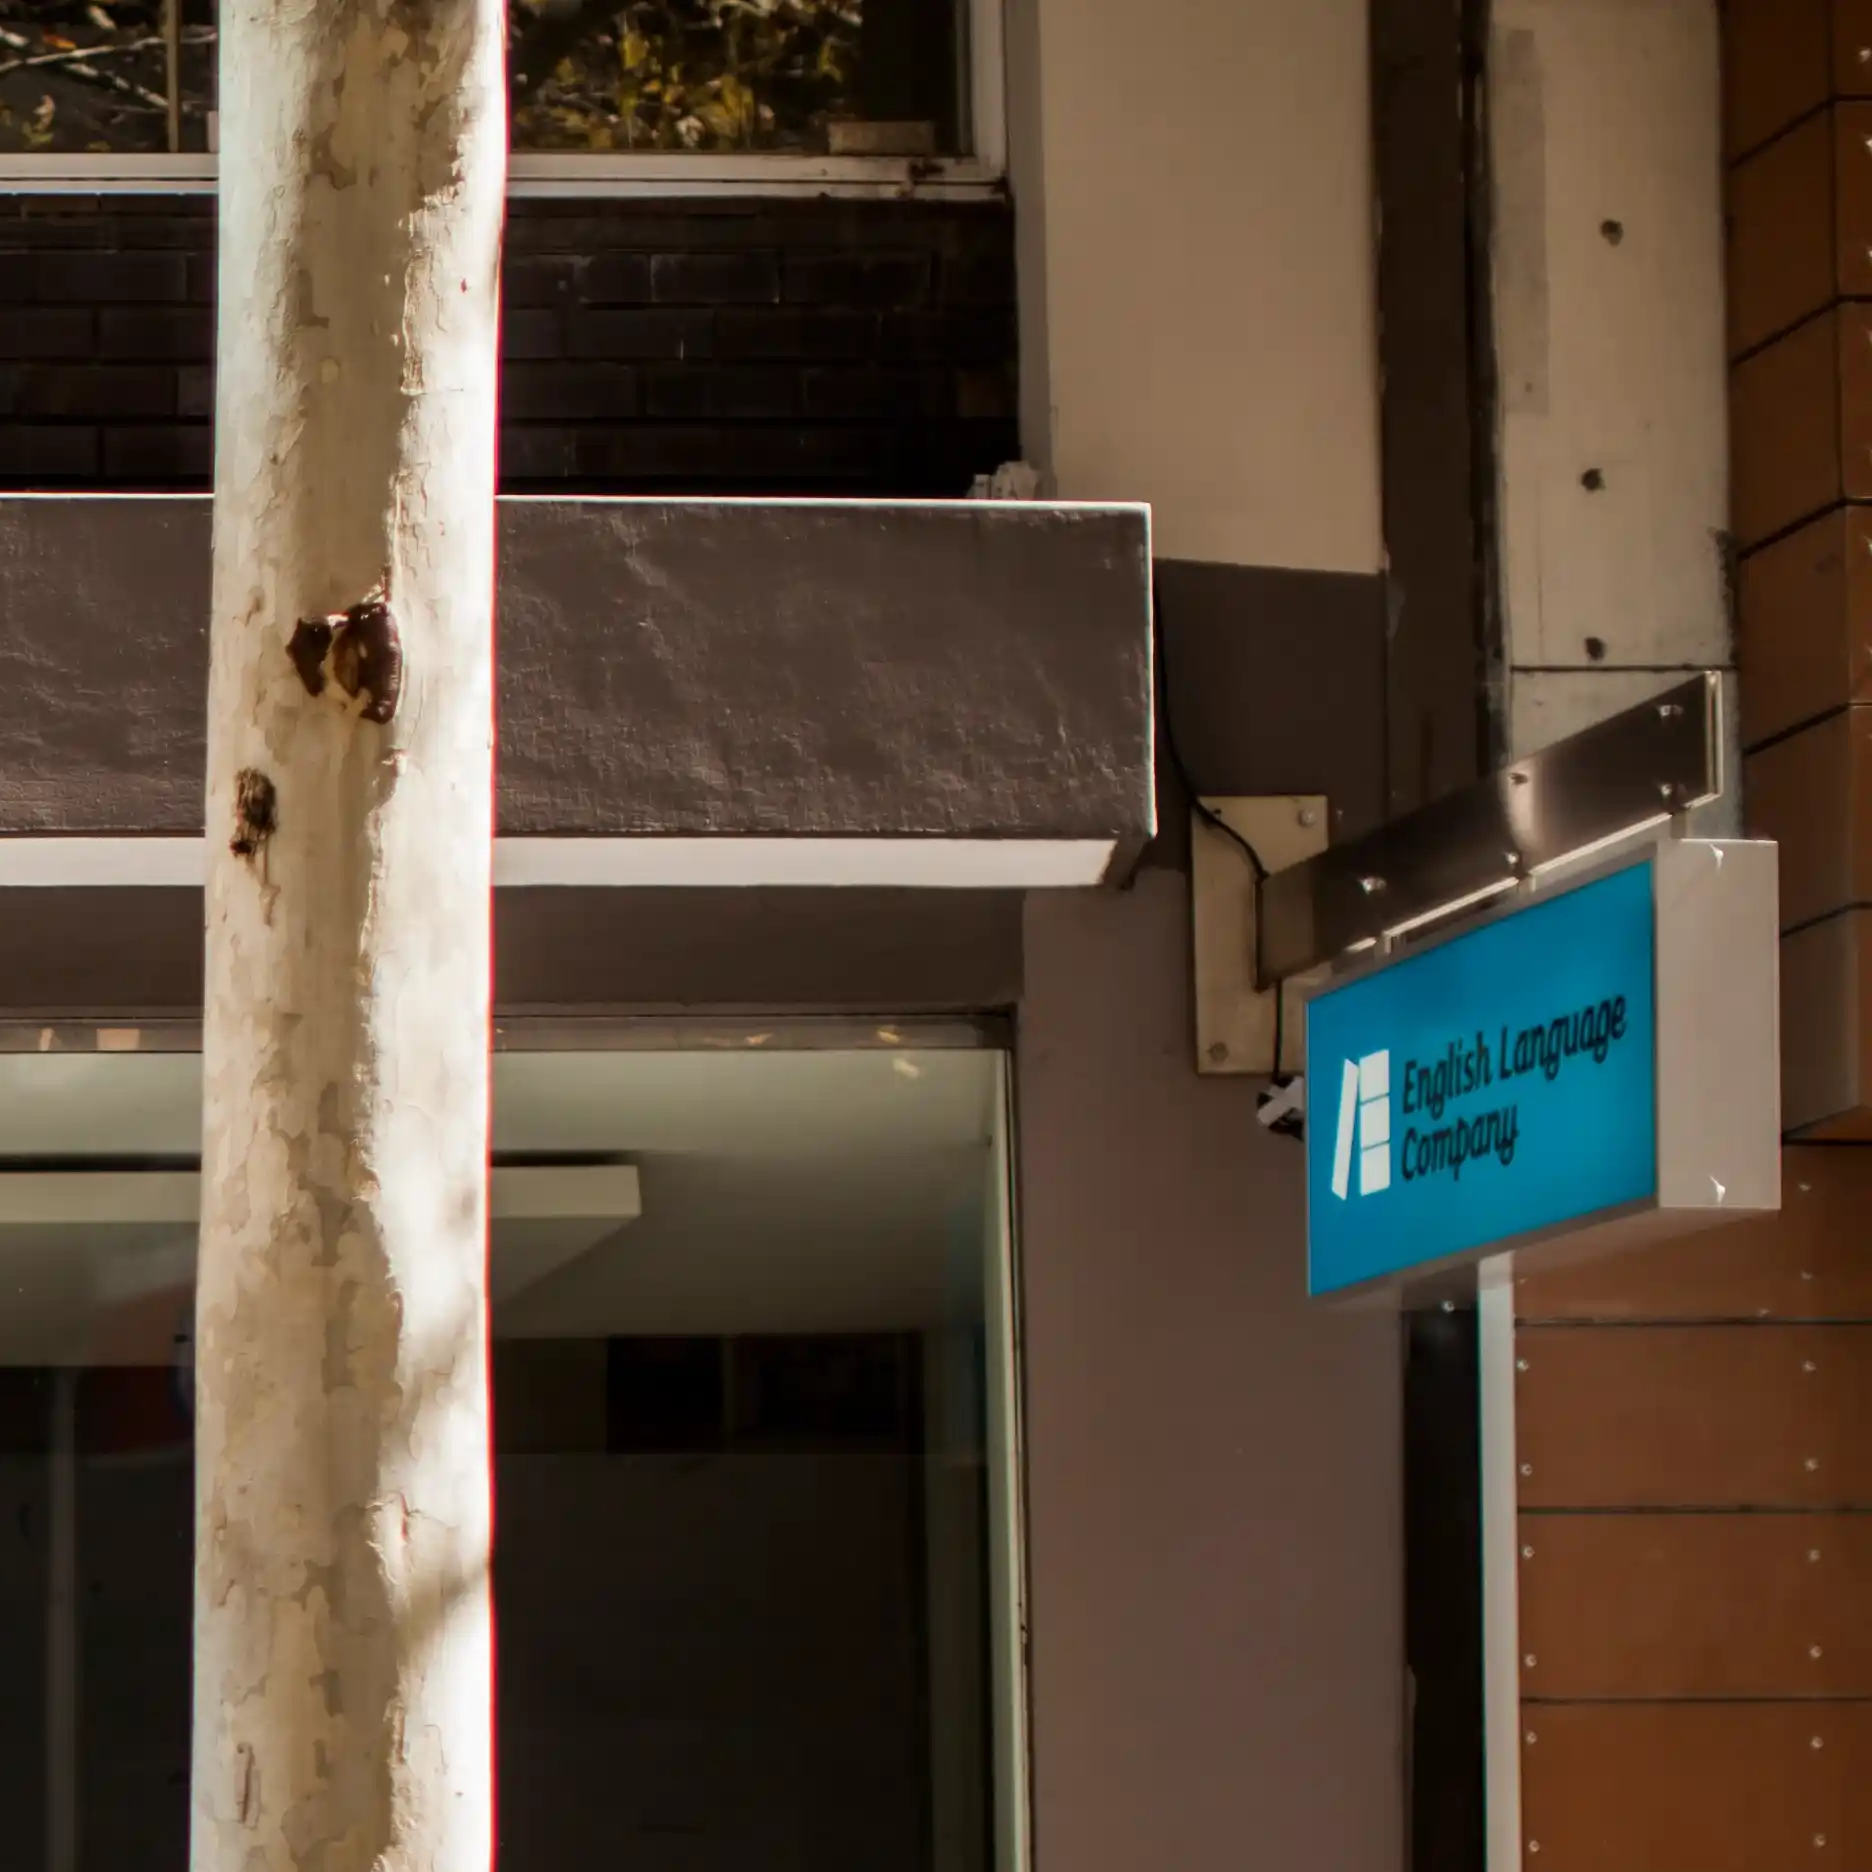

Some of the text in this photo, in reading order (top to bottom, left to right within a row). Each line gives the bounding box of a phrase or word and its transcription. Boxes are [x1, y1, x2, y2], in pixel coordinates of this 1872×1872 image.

[1402, 993, 1628, 1122] English Language
[1401, 1104, 1520, 1181] Company
